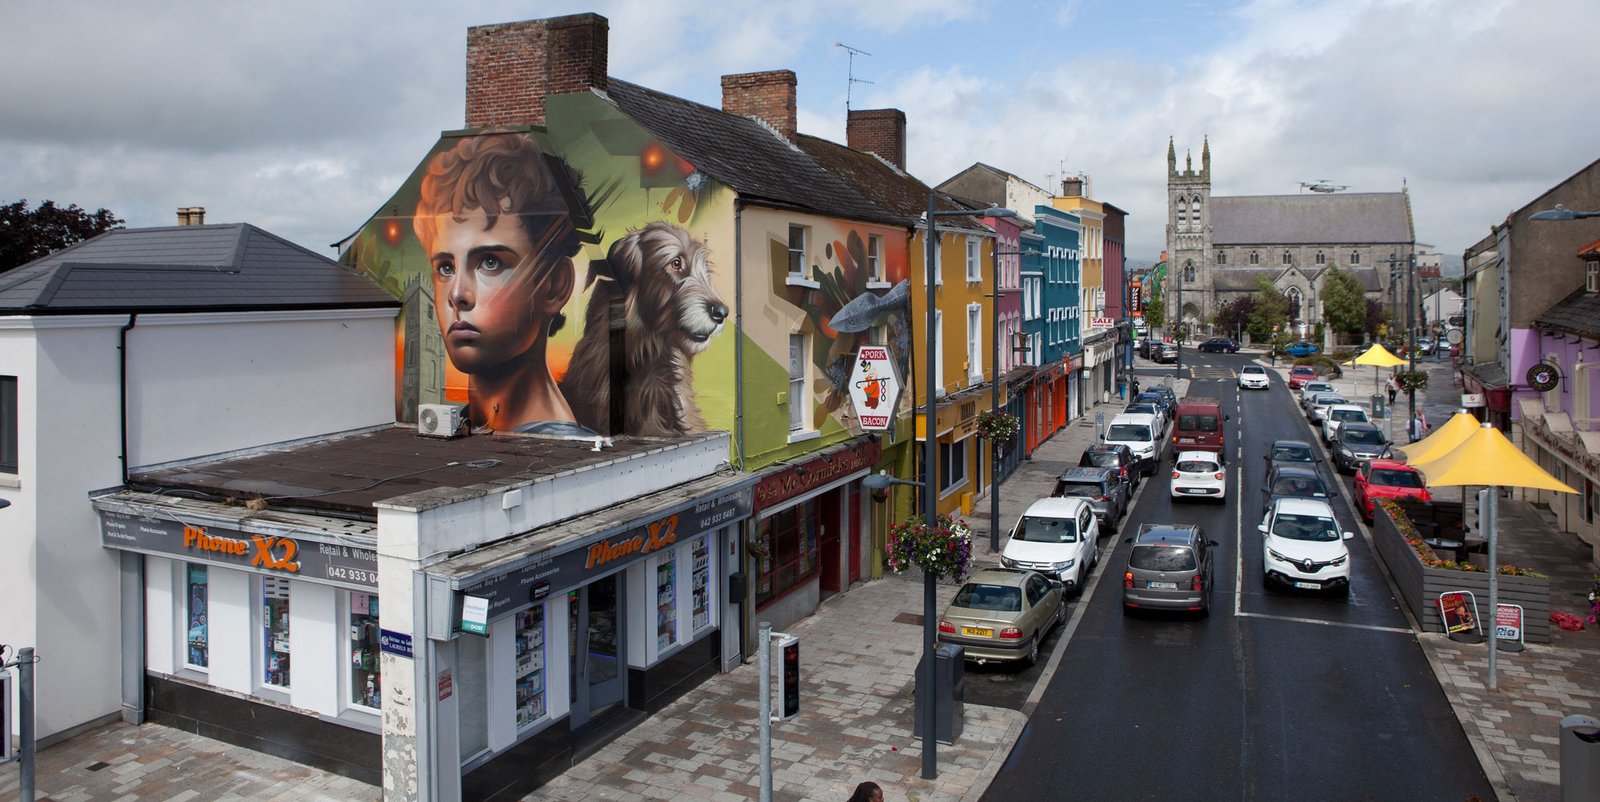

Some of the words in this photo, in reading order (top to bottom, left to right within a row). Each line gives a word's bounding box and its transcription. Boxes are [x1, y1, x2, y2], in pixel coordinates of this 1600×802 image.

[864, 350, 885, 359] PORK
[862, 417, 886, 425] BACON
[695, 502, 710, 514] Retail
[717, 490, 742, 506] Wholesale
[700, 516, 711, 529] 042
[712, 512, 722, 524] 933
[722, 508, 736, 520] 0487
[183, 526, 249, 556] Phone
[251, 535, 301, 572] X2
[585, 535, 644, 570] Phone
[642, 514, 680, 553] X2
[320, 544, 341, 557] Retail
[342, 548, 349, 558] &
[352, 548, 378, 562] Wholes
[328, 567, 346, 578] 042
[349, 569, 366, 582] 933
[370, 573, 379, 584] 04
[520, 576, 534, 585] Phone
[535, 567, 560, 580] Accessories
[534, 585, 550, 594] PHONE
[494, 597, 511, 608] Repairs
